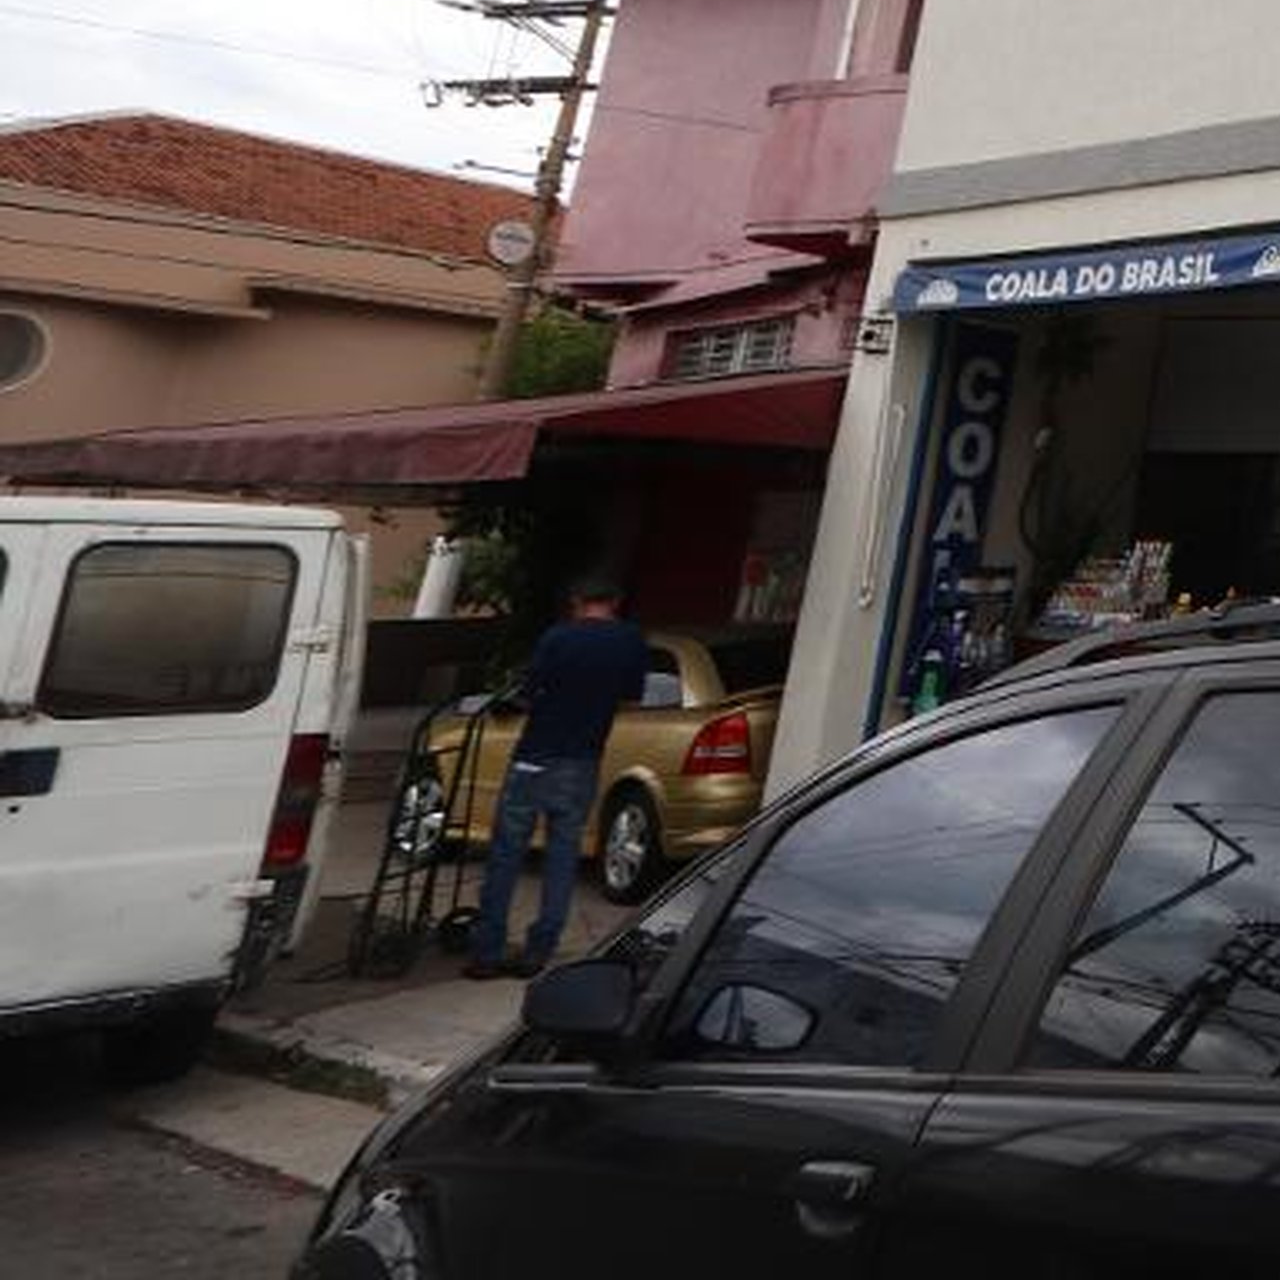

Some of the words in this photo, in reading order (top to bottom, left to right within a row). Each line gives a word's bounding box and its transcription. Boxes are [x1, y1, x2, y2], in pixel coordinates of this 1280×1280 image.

[985, 266, 1069, 302] COALA
[1073, 263, 1116, 295] DO
[1119, 252, 1220, 292] BRASIL
